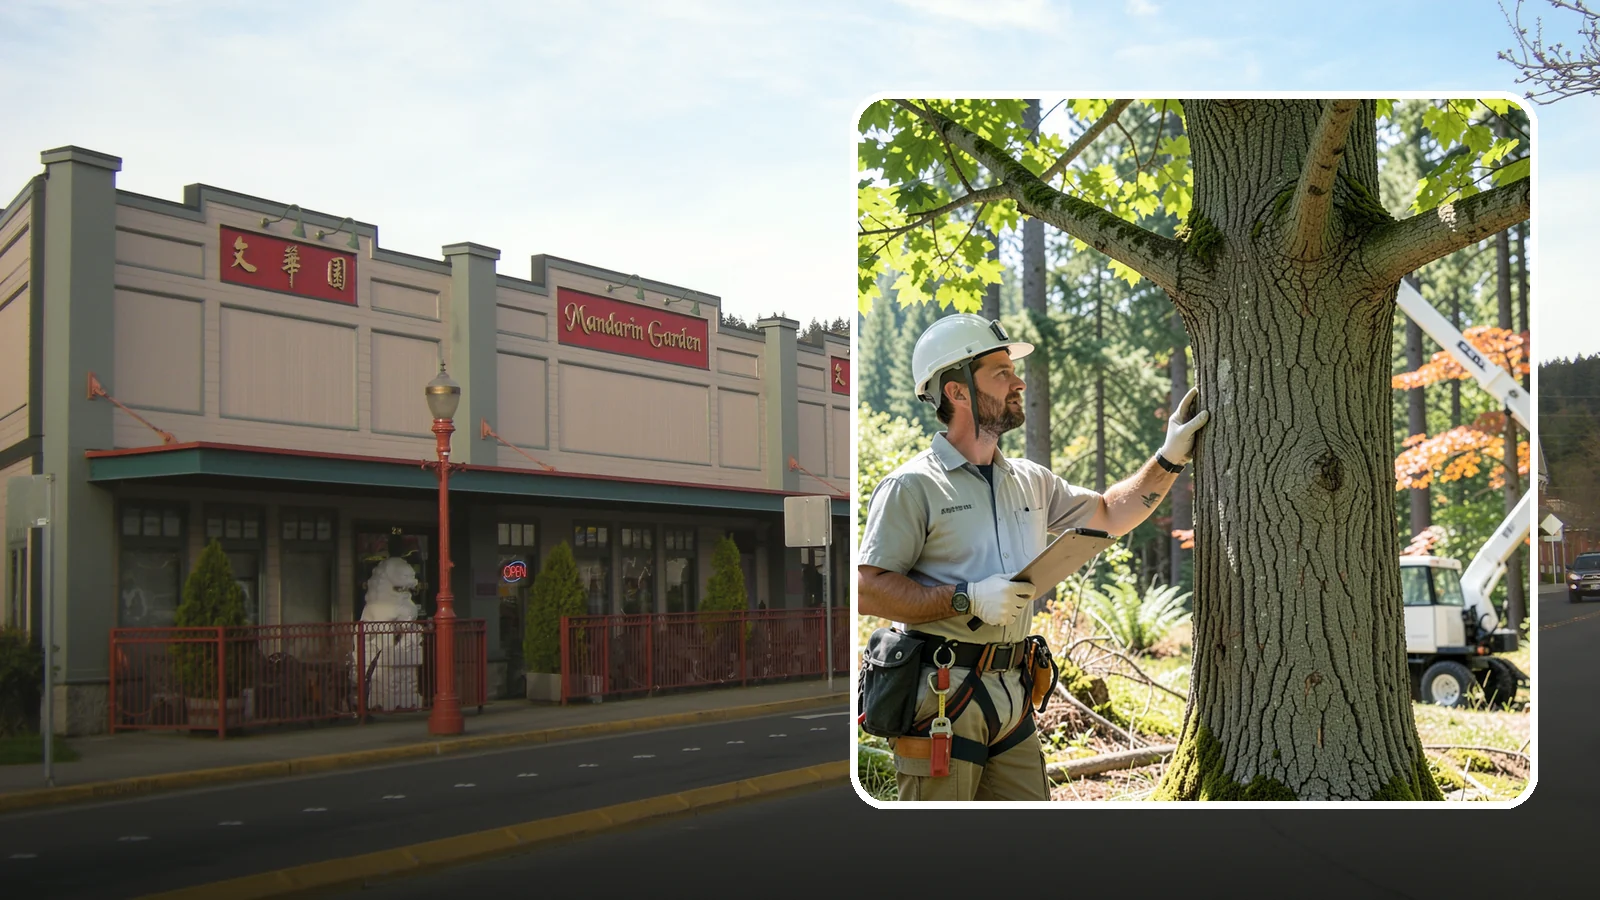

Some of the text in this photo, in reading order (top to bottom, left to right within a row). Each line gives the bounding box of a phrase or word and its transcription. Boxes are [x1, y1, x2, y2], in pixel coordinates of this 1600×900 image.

[564, 302, 701, 352] Mandarin Garden
[503, 565, 527, 578] OPEN
